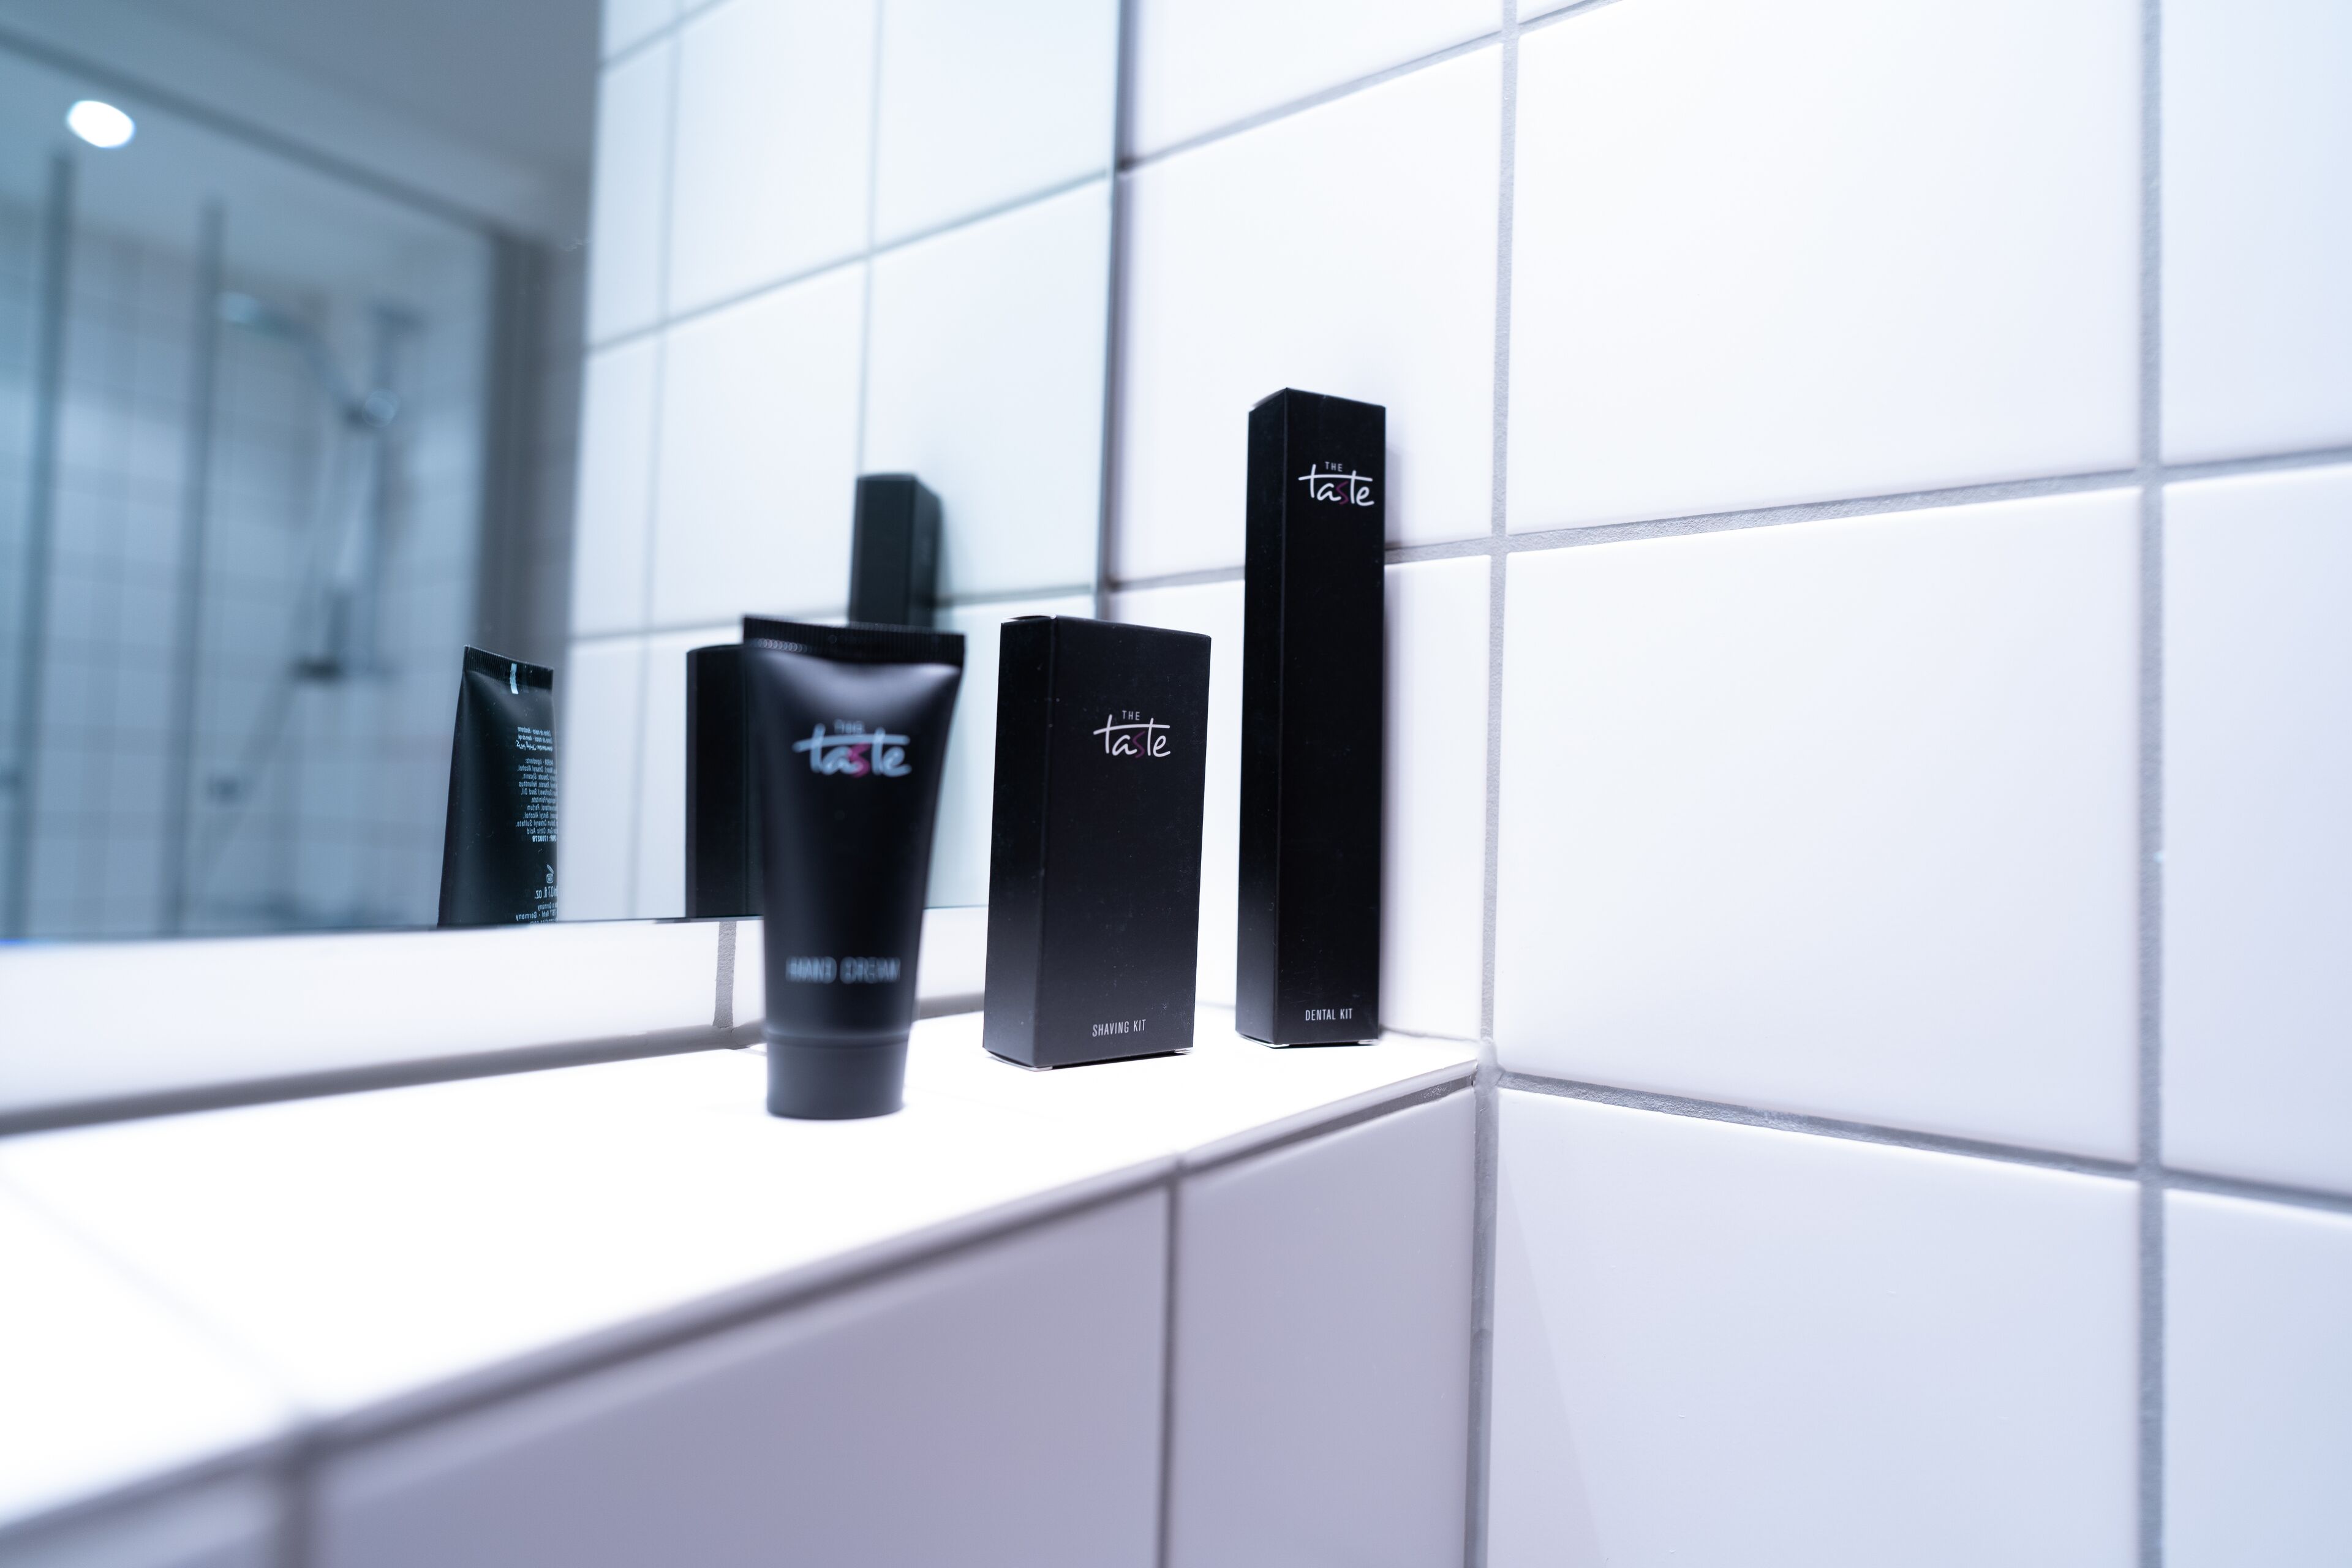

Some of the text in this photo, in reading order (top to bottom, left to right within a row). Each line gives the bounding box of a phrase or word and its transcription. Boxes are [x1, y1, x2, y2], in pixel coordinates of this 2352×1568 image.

[1324, 461, 1343, 472] THE
[1298, 464, 1374, 507] taste
[1122, 710, 1140, 721] THE
[1093, 714, 1171, 758] taste
[792, 723, 912, 777] taste
[1305, 1008, 1353, 1021] DENTAL KIT
[1092, 1019, 1147, 1037] SHAVING KIT
